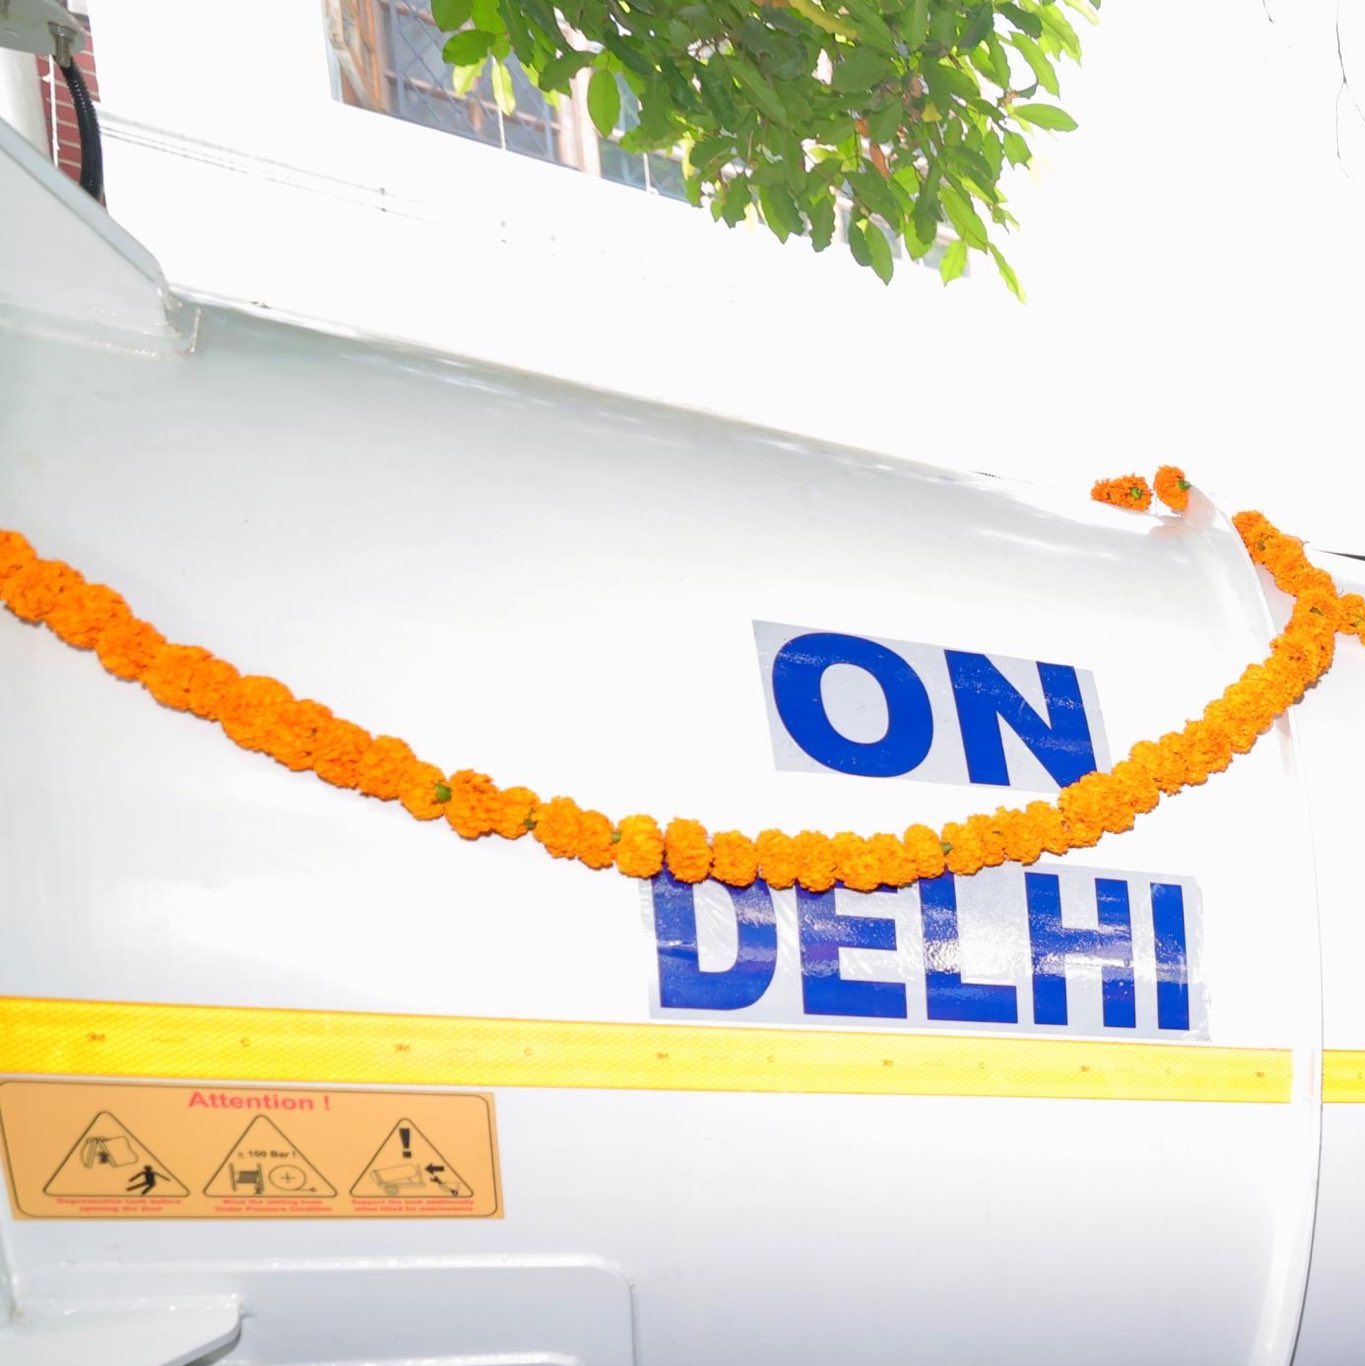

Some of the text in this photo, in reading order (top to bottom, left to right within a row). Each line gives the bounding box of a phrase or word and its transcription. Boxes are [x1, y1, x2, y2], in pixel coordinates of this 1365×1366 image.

[772, 631, 1099, 789] ON
[650, 862, 1190, 1031] DELHI
[188, 1091, 331, 1110] Attention !
